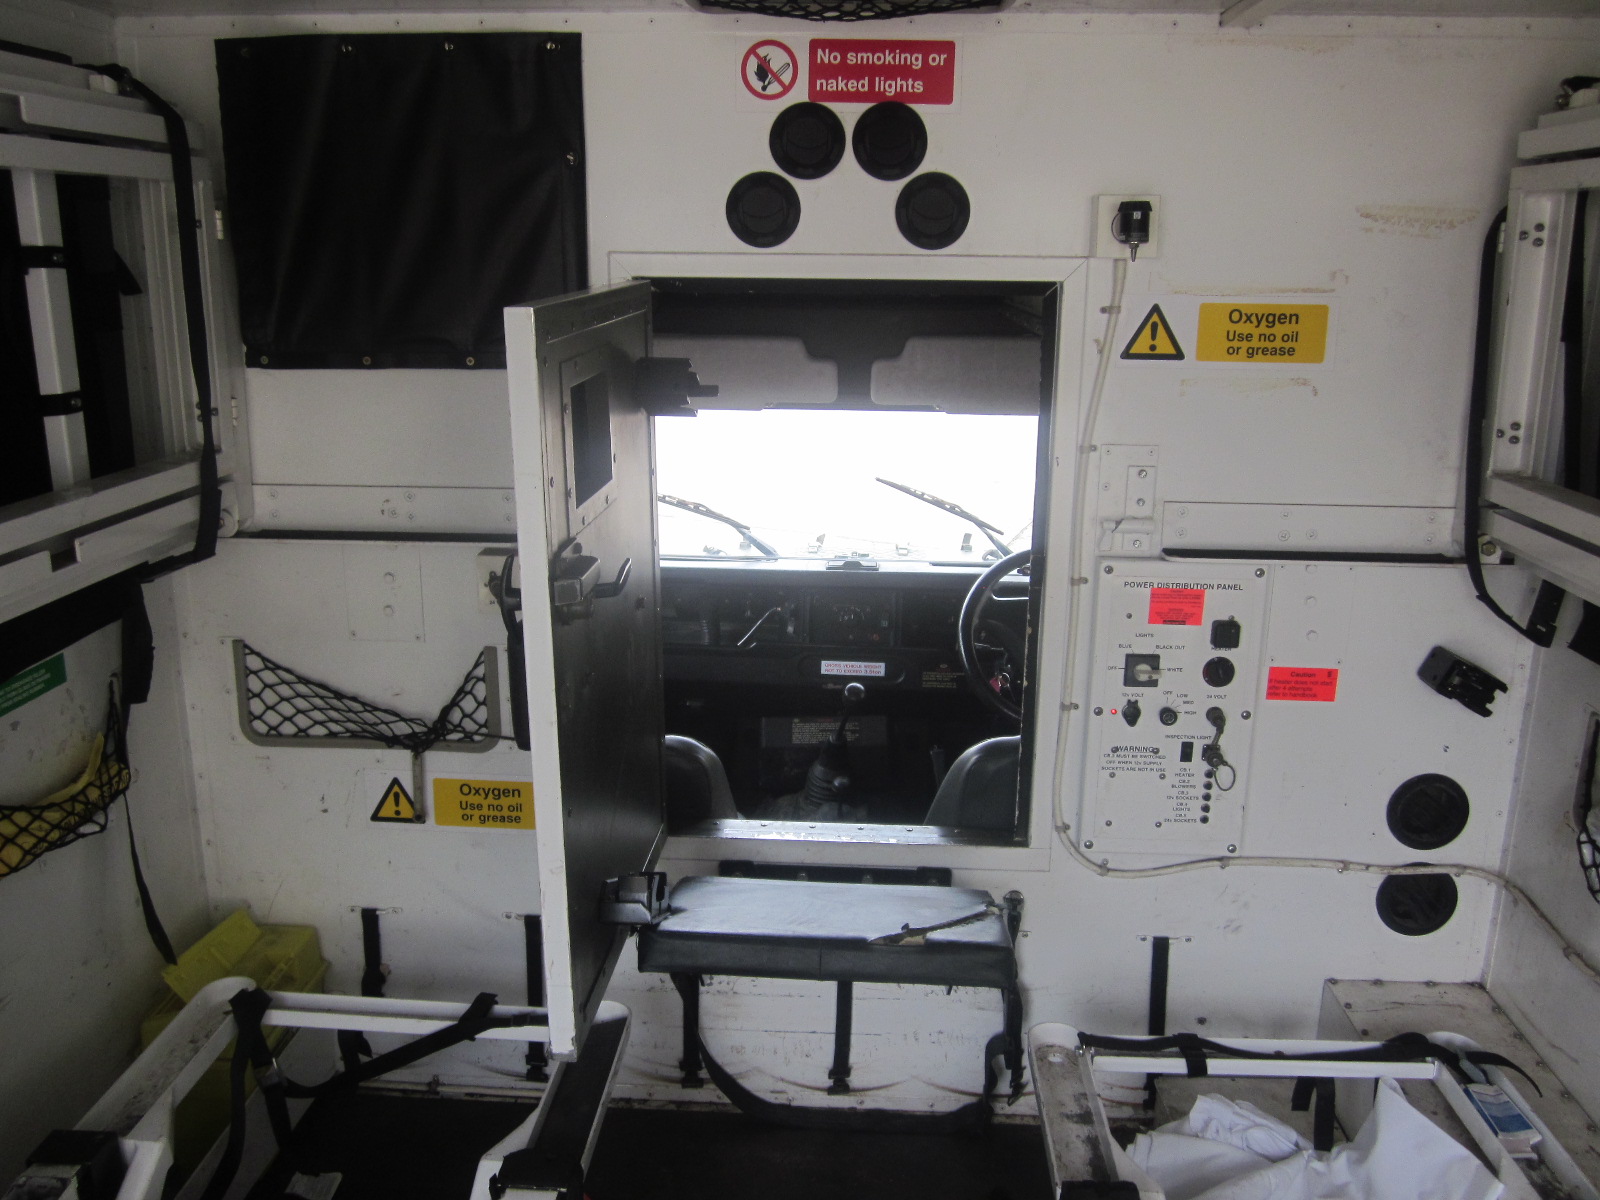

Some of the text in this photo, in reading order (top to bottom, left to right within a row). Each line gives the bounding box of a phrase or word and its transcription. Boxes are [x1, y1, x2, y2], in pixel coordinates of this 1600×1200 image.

[817, 48, 947, 69] No smoking or
[816, 76, 923, 95] naked lights
[1229, 309, 1299, 328] Oxygen
[1226, 330, 1298, 343] Use no oil
[1227, 345, 1295, 358] or grease
[460, 784, 521, 800] Oxygen
[460, 801, 522, 812] Use no oil
[479, 813, 521, 824] grease
